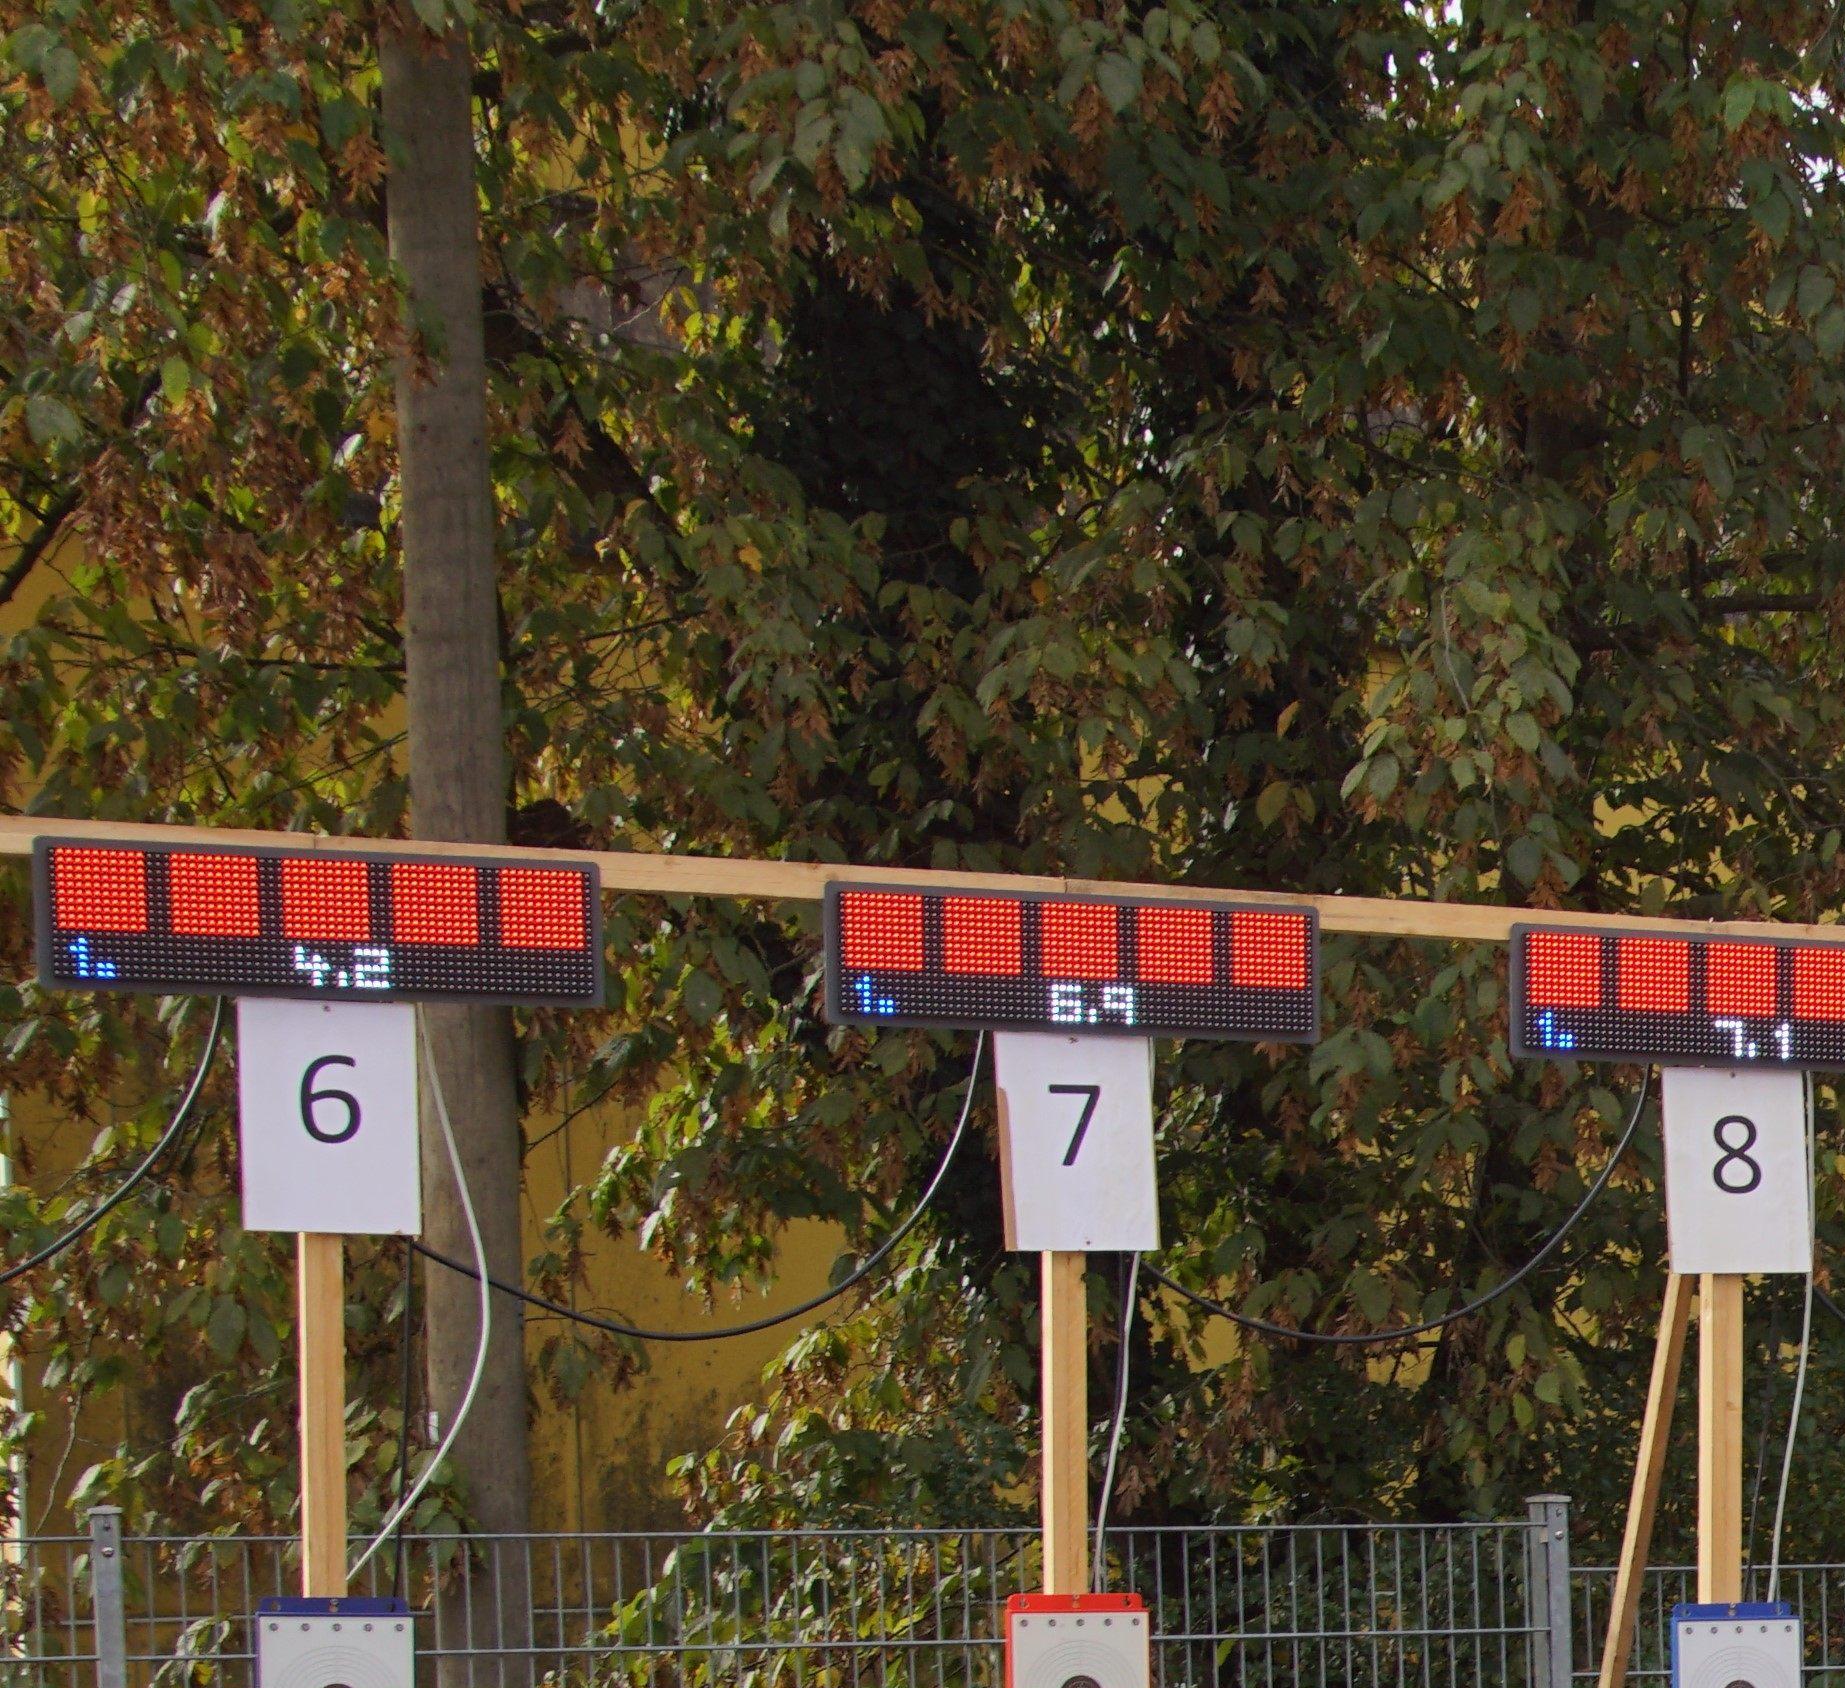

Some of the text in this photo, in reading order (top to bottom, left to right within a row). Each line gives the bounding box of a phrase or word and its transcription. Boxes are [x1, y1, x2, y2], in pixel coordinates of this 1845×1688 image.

[295, 945, 390, 989] 4.2
[1050, 983, 1135, 1025] 6.9
[1714, 1019, 1790, 1060] 7.1
[299, 1054, 361, 1144] 6
[1047, 1083, 1100, 1167] 7
[1711, 1114, 1763, 1195] 8
